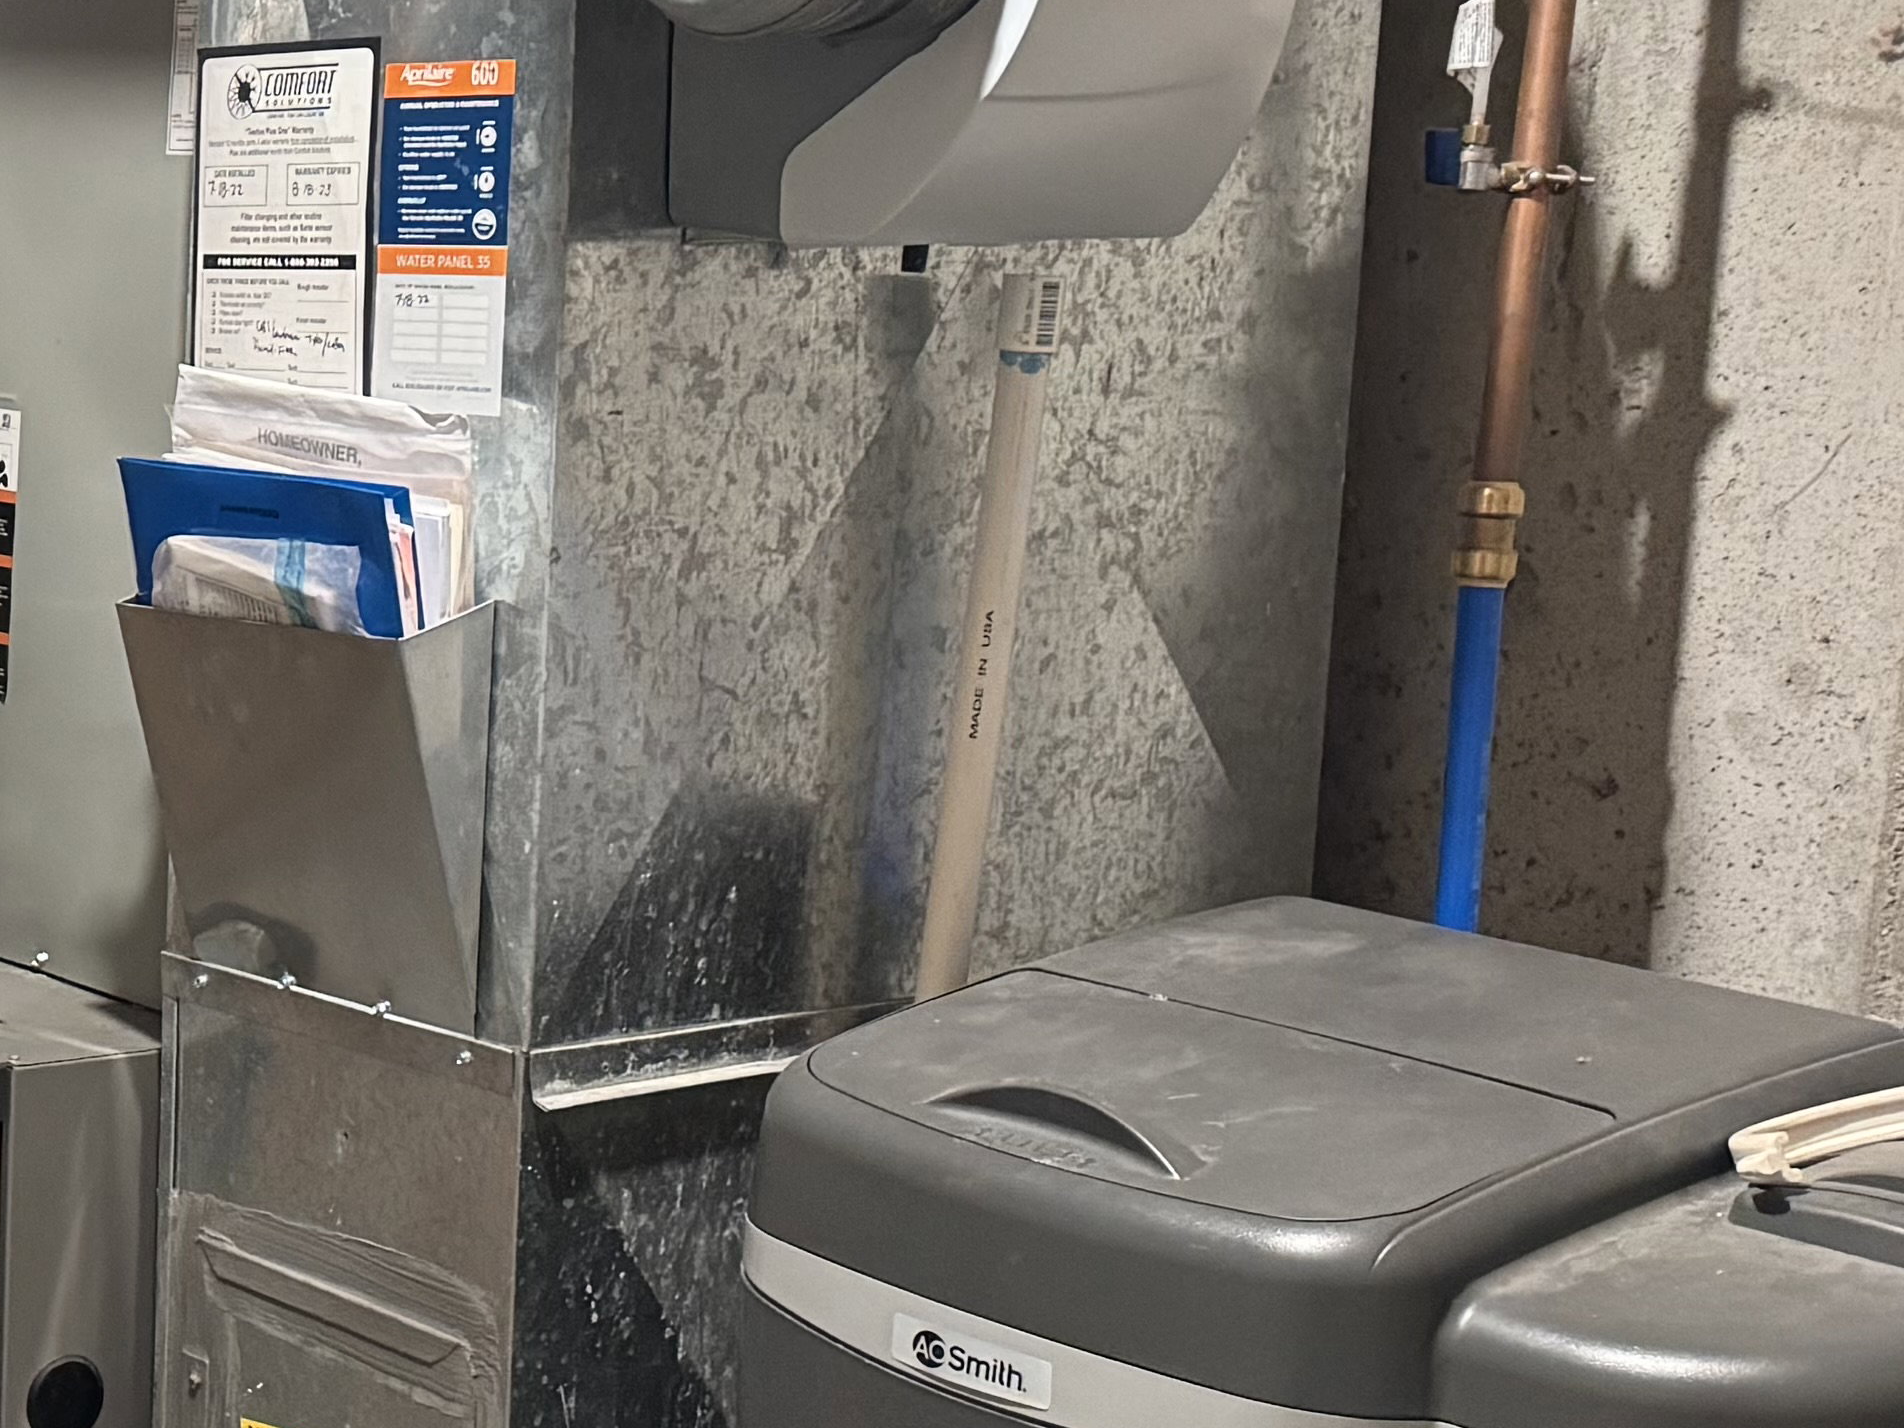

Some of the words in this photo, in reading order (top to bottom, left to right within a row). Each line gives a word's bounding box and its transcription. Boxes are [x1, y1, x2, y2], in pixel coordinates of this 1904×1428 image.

[264, 70, 336, 97] COMFORT
[400, 64, 455, 84] Aprilaire
[471, 61, 499, 86] 600
[264, 97, 332, 107] SOLUTIONS
[396, 255, 435, 268] WATER
[437, 255, 473, 269] PANEL
[476, 255, 491, 269] 35
[258, 427, 362, 467] HOMEOWNER,
